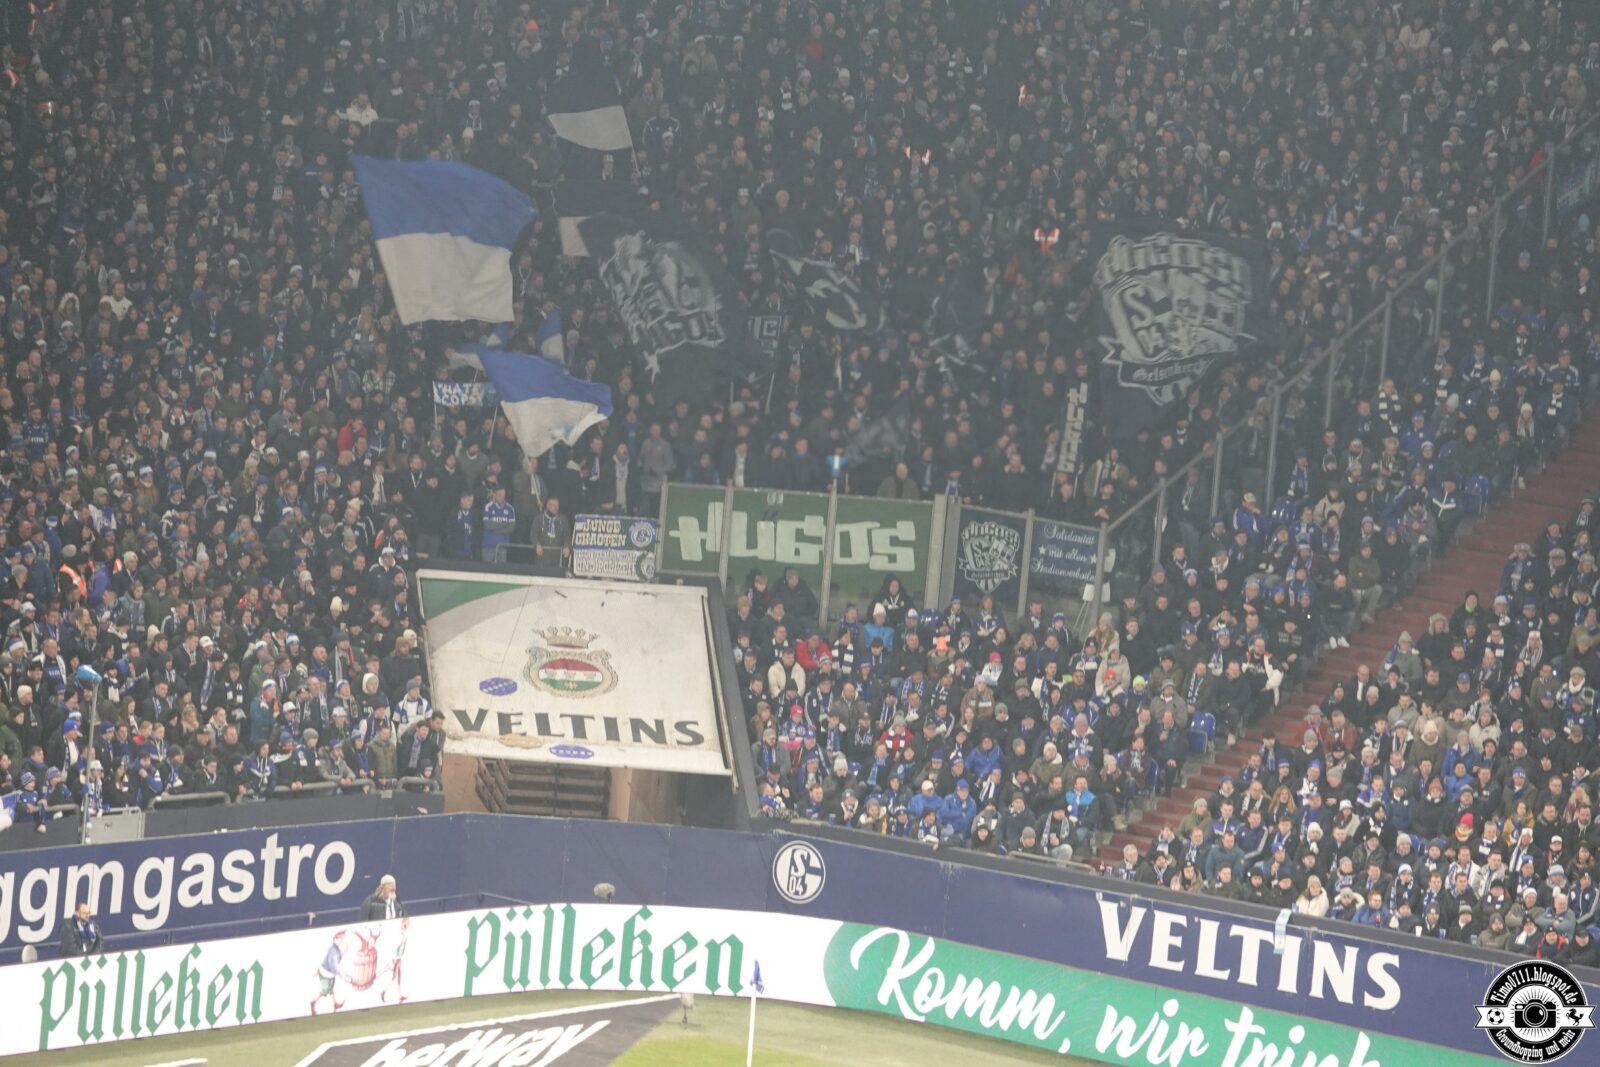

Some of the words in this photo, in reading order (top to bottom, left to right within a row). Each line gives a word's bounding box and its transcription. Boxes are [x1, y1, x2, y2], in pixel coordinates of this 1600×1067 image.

[575, 532, 627, 547] CHAOTEN
[582, 518, 621, 533] JUNGE
[450, 707, 706, 747] VELTINS
[790, 848, 809, 876] S
[788, 875, 804, 896] 04
[463, 903, 744, 997] Pülleken
[1096, 898, 1402, 1011] VELTINS
[39, 943, 264, 1051] Pülleken
[851, 926, 1071, 1054] Komm,
[1095, 999, 1209, 1067] wir
